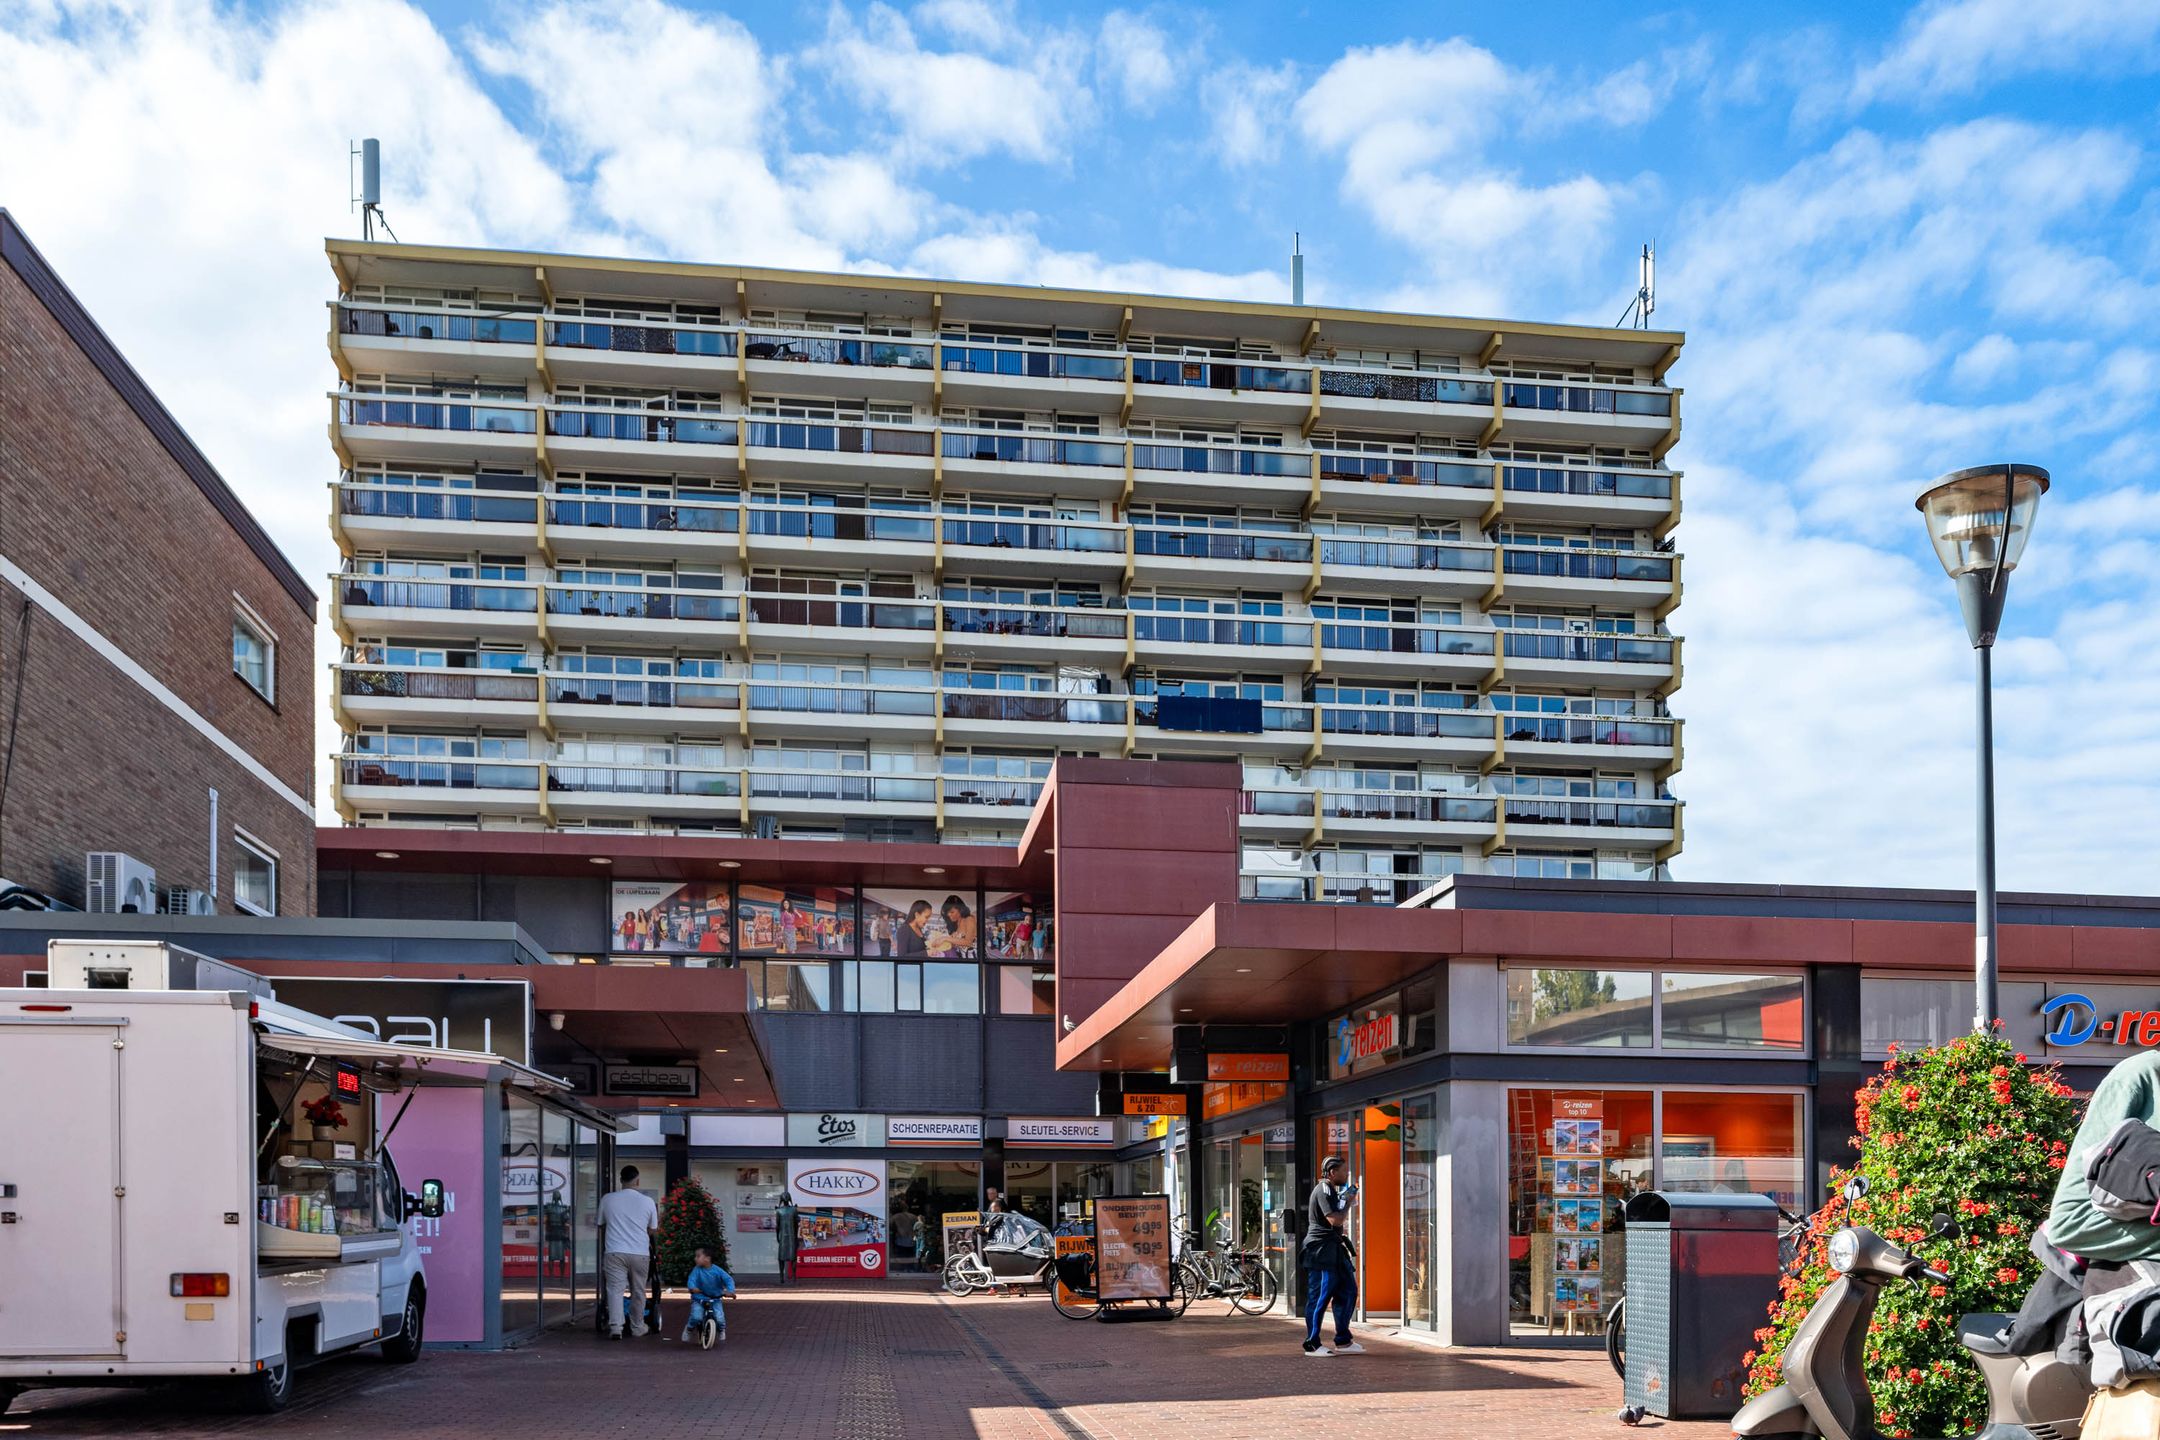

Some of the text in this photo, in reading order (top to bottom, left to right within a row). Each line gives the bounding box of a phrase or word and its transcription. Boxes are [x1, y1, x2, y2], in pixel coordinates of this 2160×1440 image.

[1337, 1010, 1394, 1066] D-reizen
[1129, 1096, 1162, 1104] RIJWIEL
[1563, 1101, 1593, 1109] D-reizen
[818, 1114, 856, 1134] Etos
[892, 1123, 978, 1134] SCHOENREPARATIE
[1020, 1125, 1099, 1136] SLEUTEL-SERVICE
[809, 1175, 866, 1188] HAKKY
[945, 1215, 978, 1223] ZEEMAN
